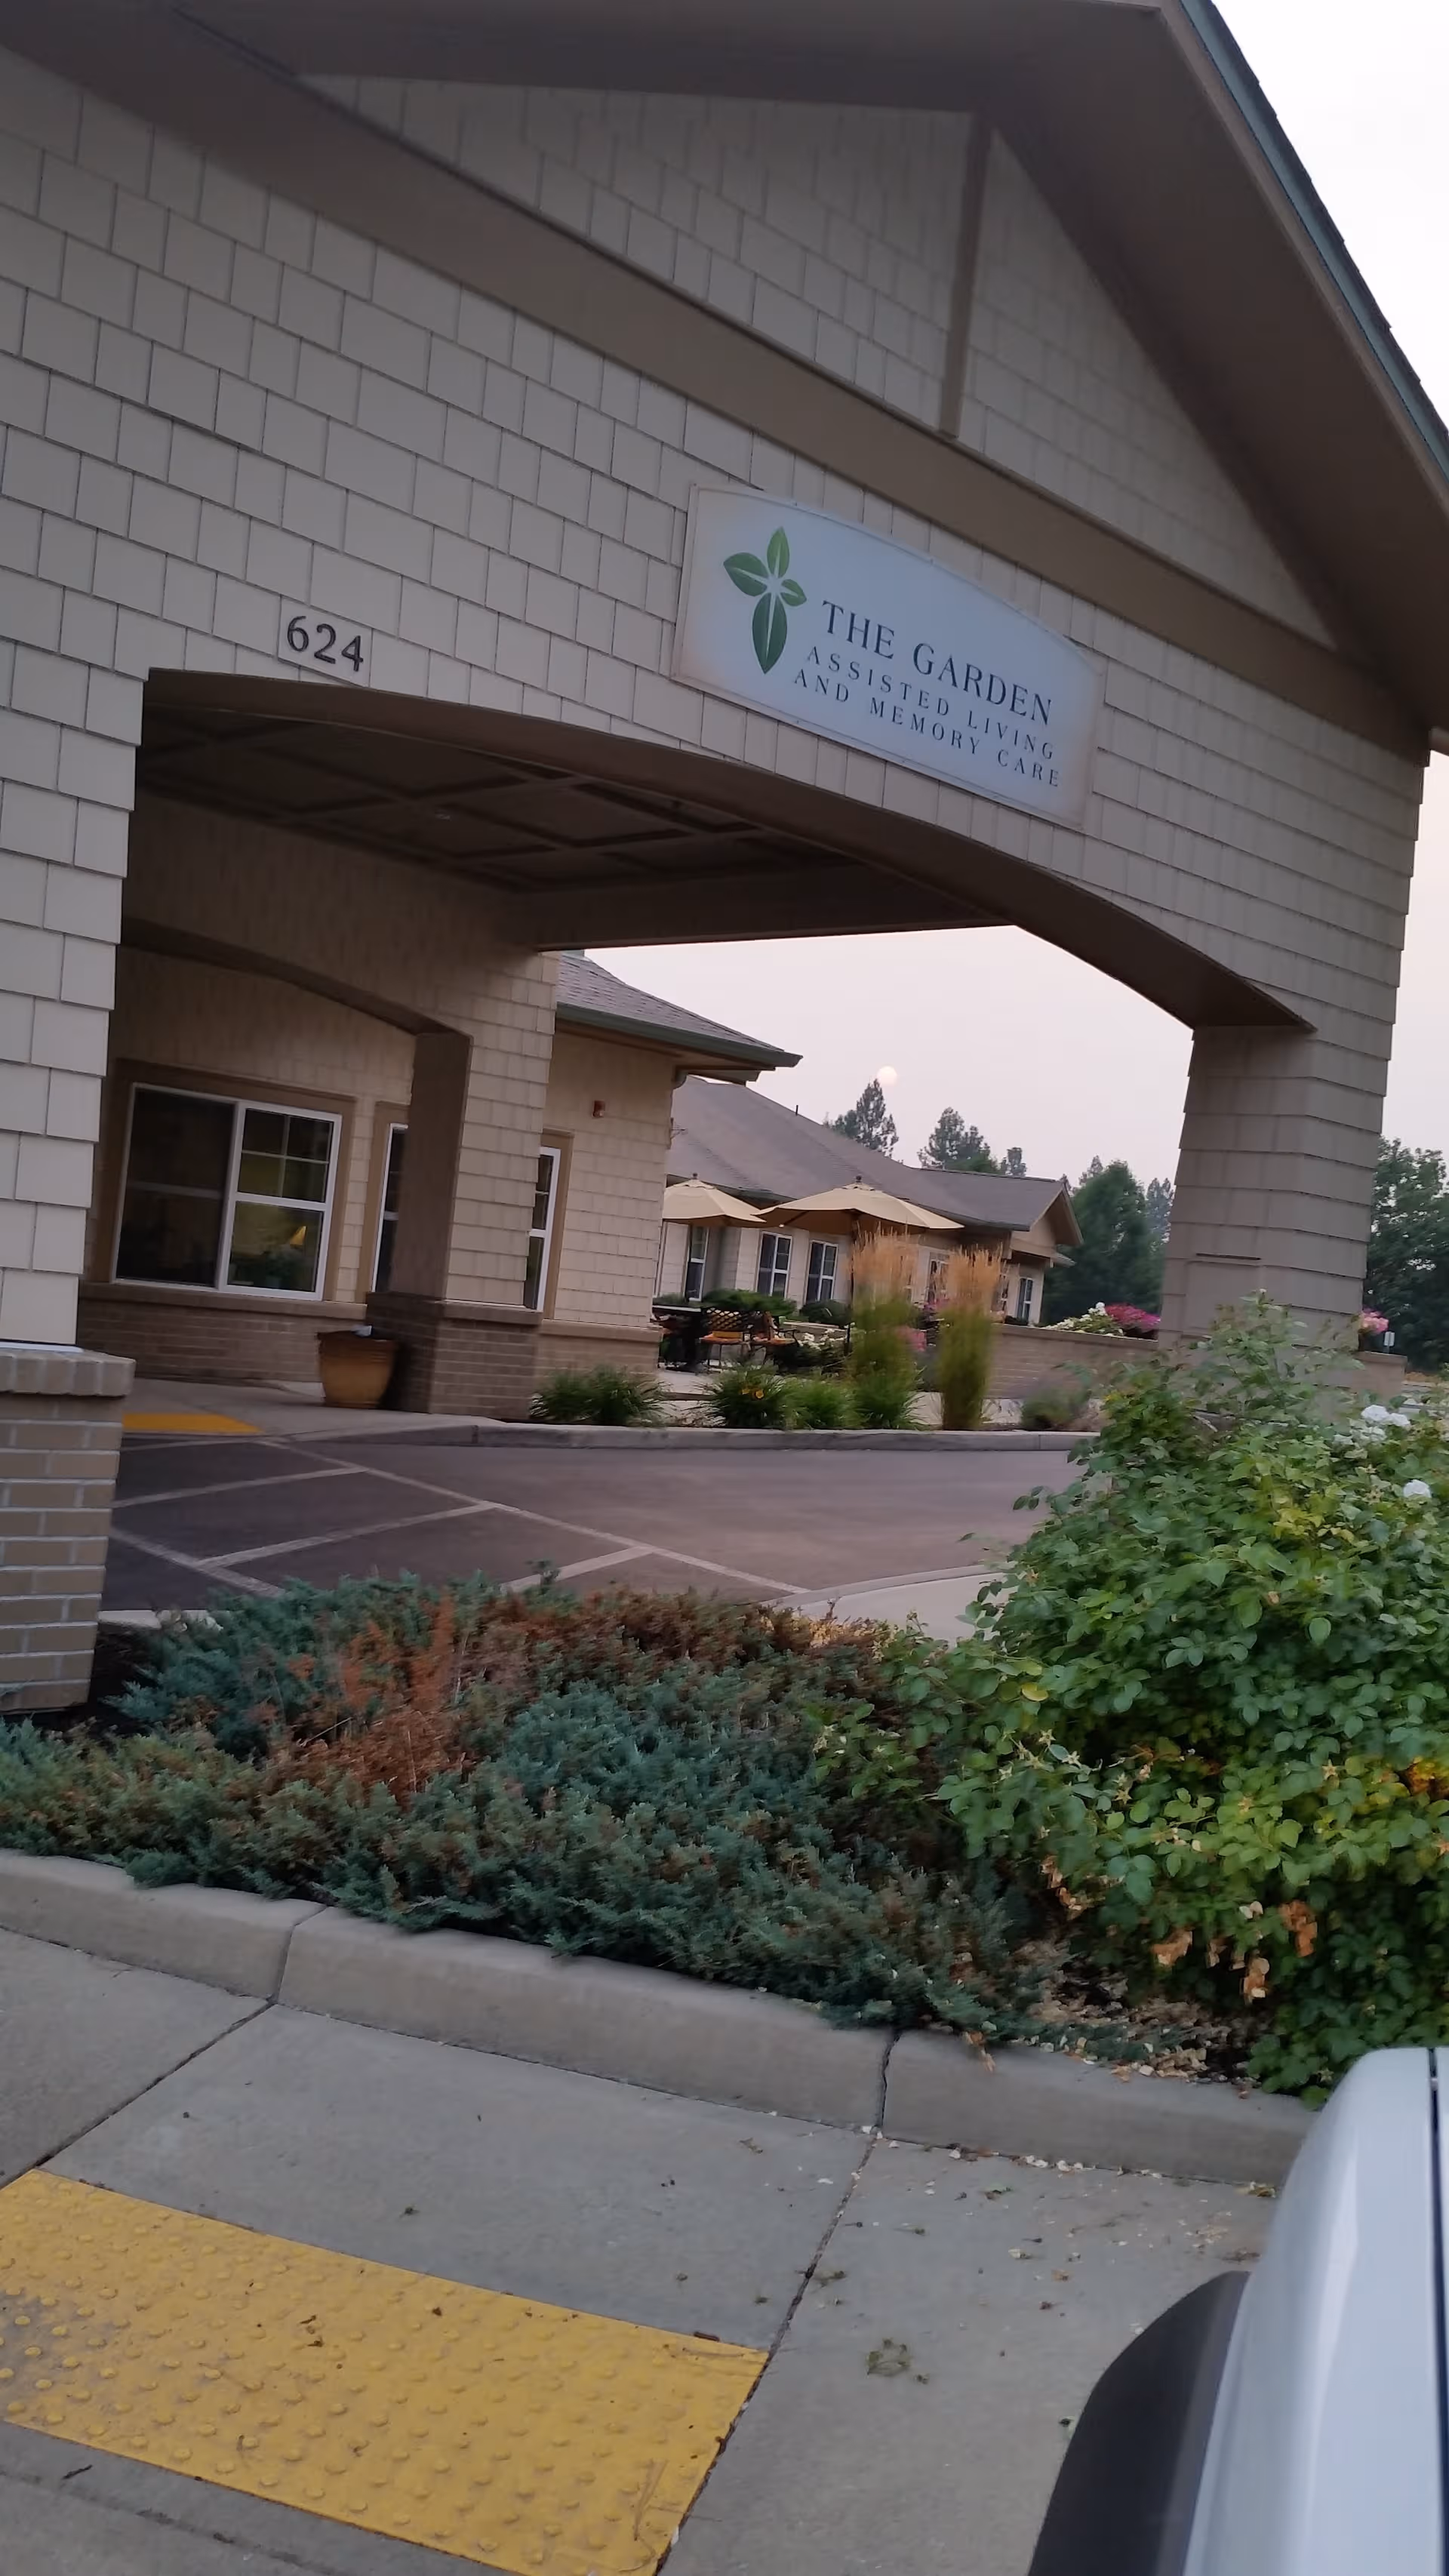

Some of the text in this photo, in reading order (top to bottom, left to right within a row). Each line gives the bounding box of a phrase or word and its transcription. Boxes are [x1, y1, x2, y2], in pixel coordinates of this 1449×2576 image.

[287, 615, 364, 672] 624
[822, 600, 1052, 726] THE GARDEN
[794, 668, 1060, 788] AND MEMORY CARE
[807, 645, 1054, 760] ASSISTED LIVING
